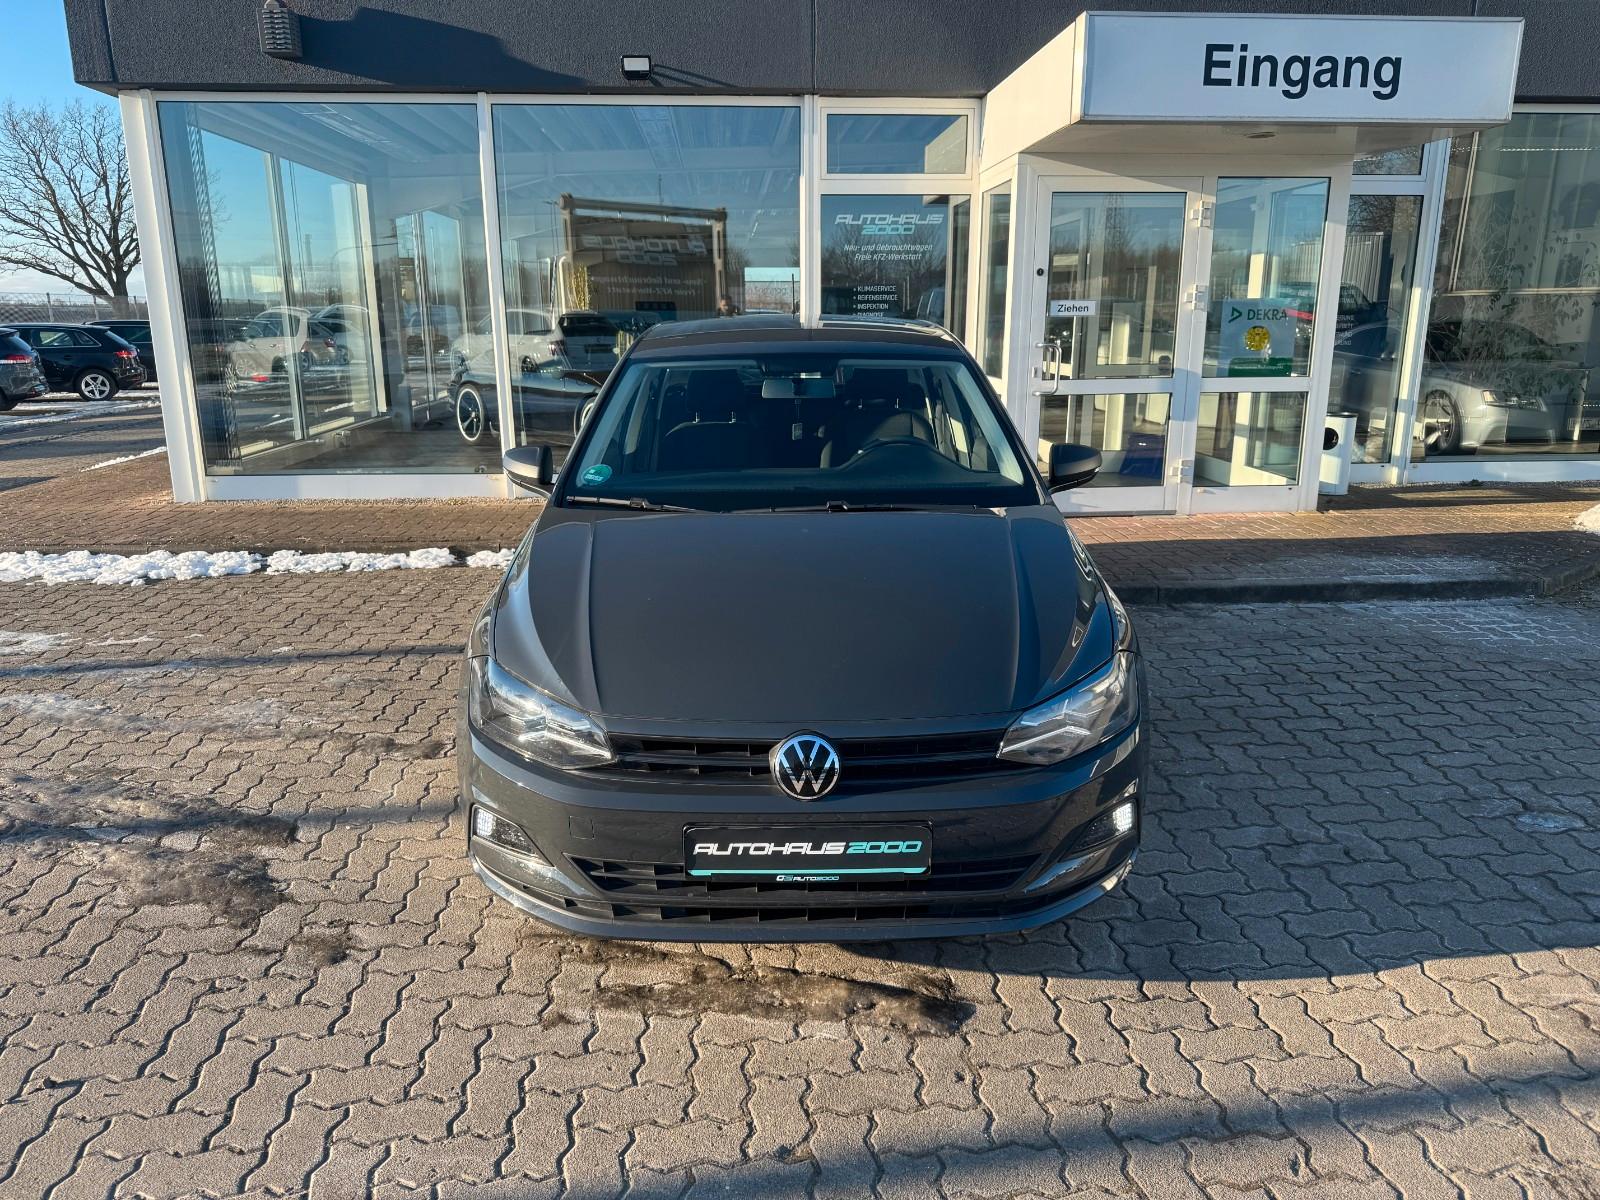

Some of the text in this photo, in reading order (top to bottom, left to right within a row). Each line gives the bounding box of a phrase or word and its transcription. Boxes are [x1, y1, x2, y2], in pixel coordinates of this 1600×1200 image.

[1203, 43, 1402, 100] Eingang
[834, 214, 944, 225] AUTOHAUS
[861, 225, 915, 235] 2000
[876, 243, 933, 252] Gebrauchtwagen
[854, 253, 871, 261] Freie
[1057, 304, 1089, 313] Ziehen
[1247, 308, 1287, 321] DEKRA
